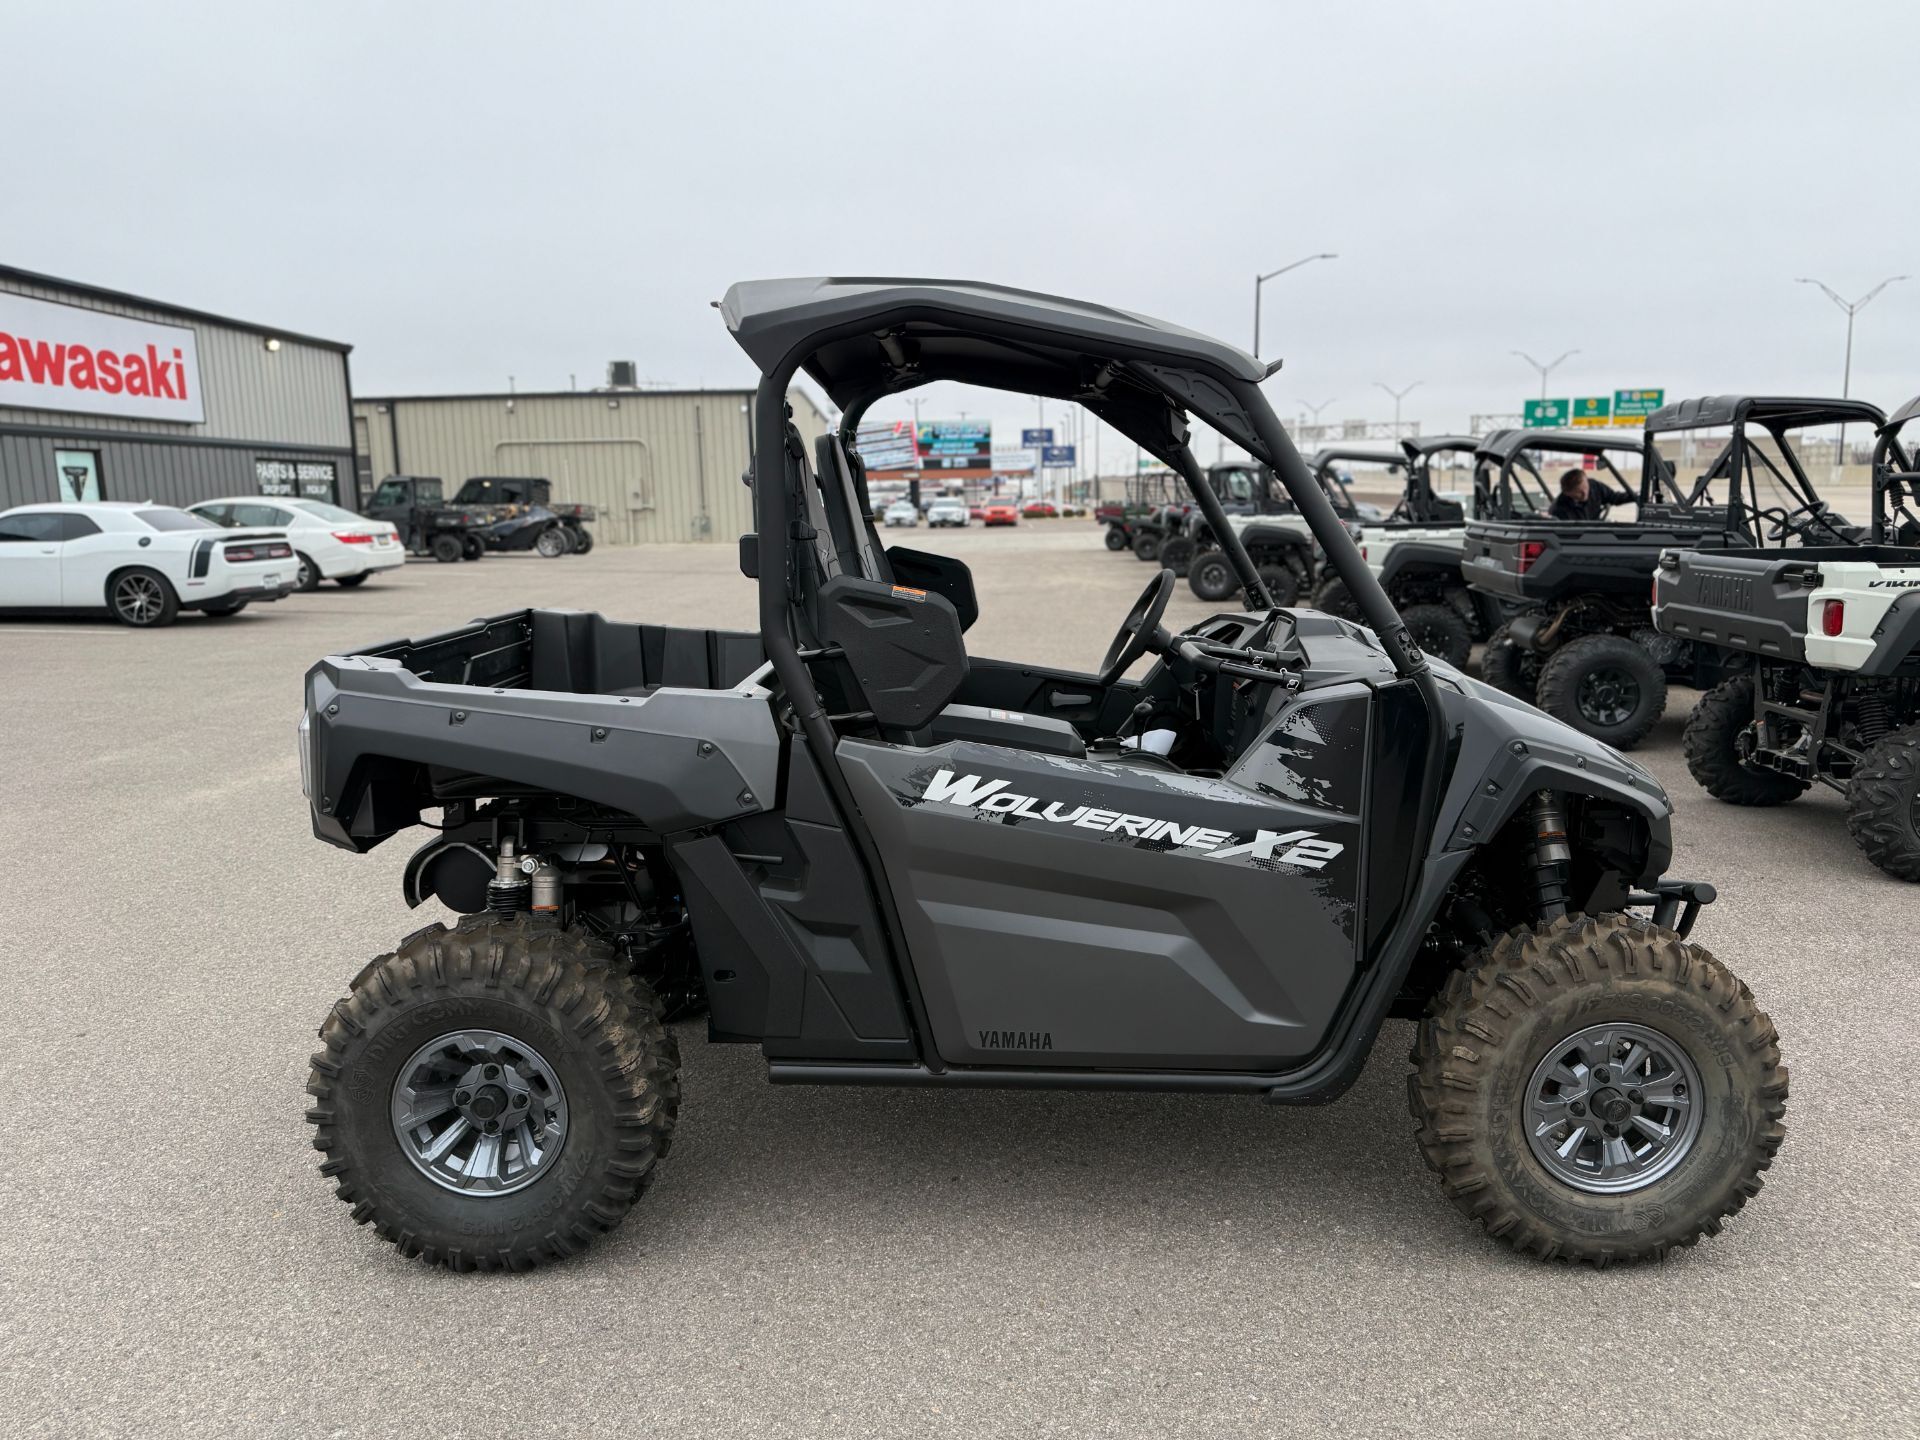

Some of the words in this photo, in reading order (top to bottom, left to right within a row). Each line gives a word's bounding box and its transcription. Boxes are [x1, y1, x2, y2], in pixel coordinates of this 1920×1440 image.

[256, 462, 287, 479] PARTS
[288, 463, 296, 479] &
[297, 463, 334, 480] SERVICE
[921, 769, 1235, 850] WOLVERINE
[1203, 829, 1344, 868] X2
[978, 1029, 1053, 1050] YAMAHA
